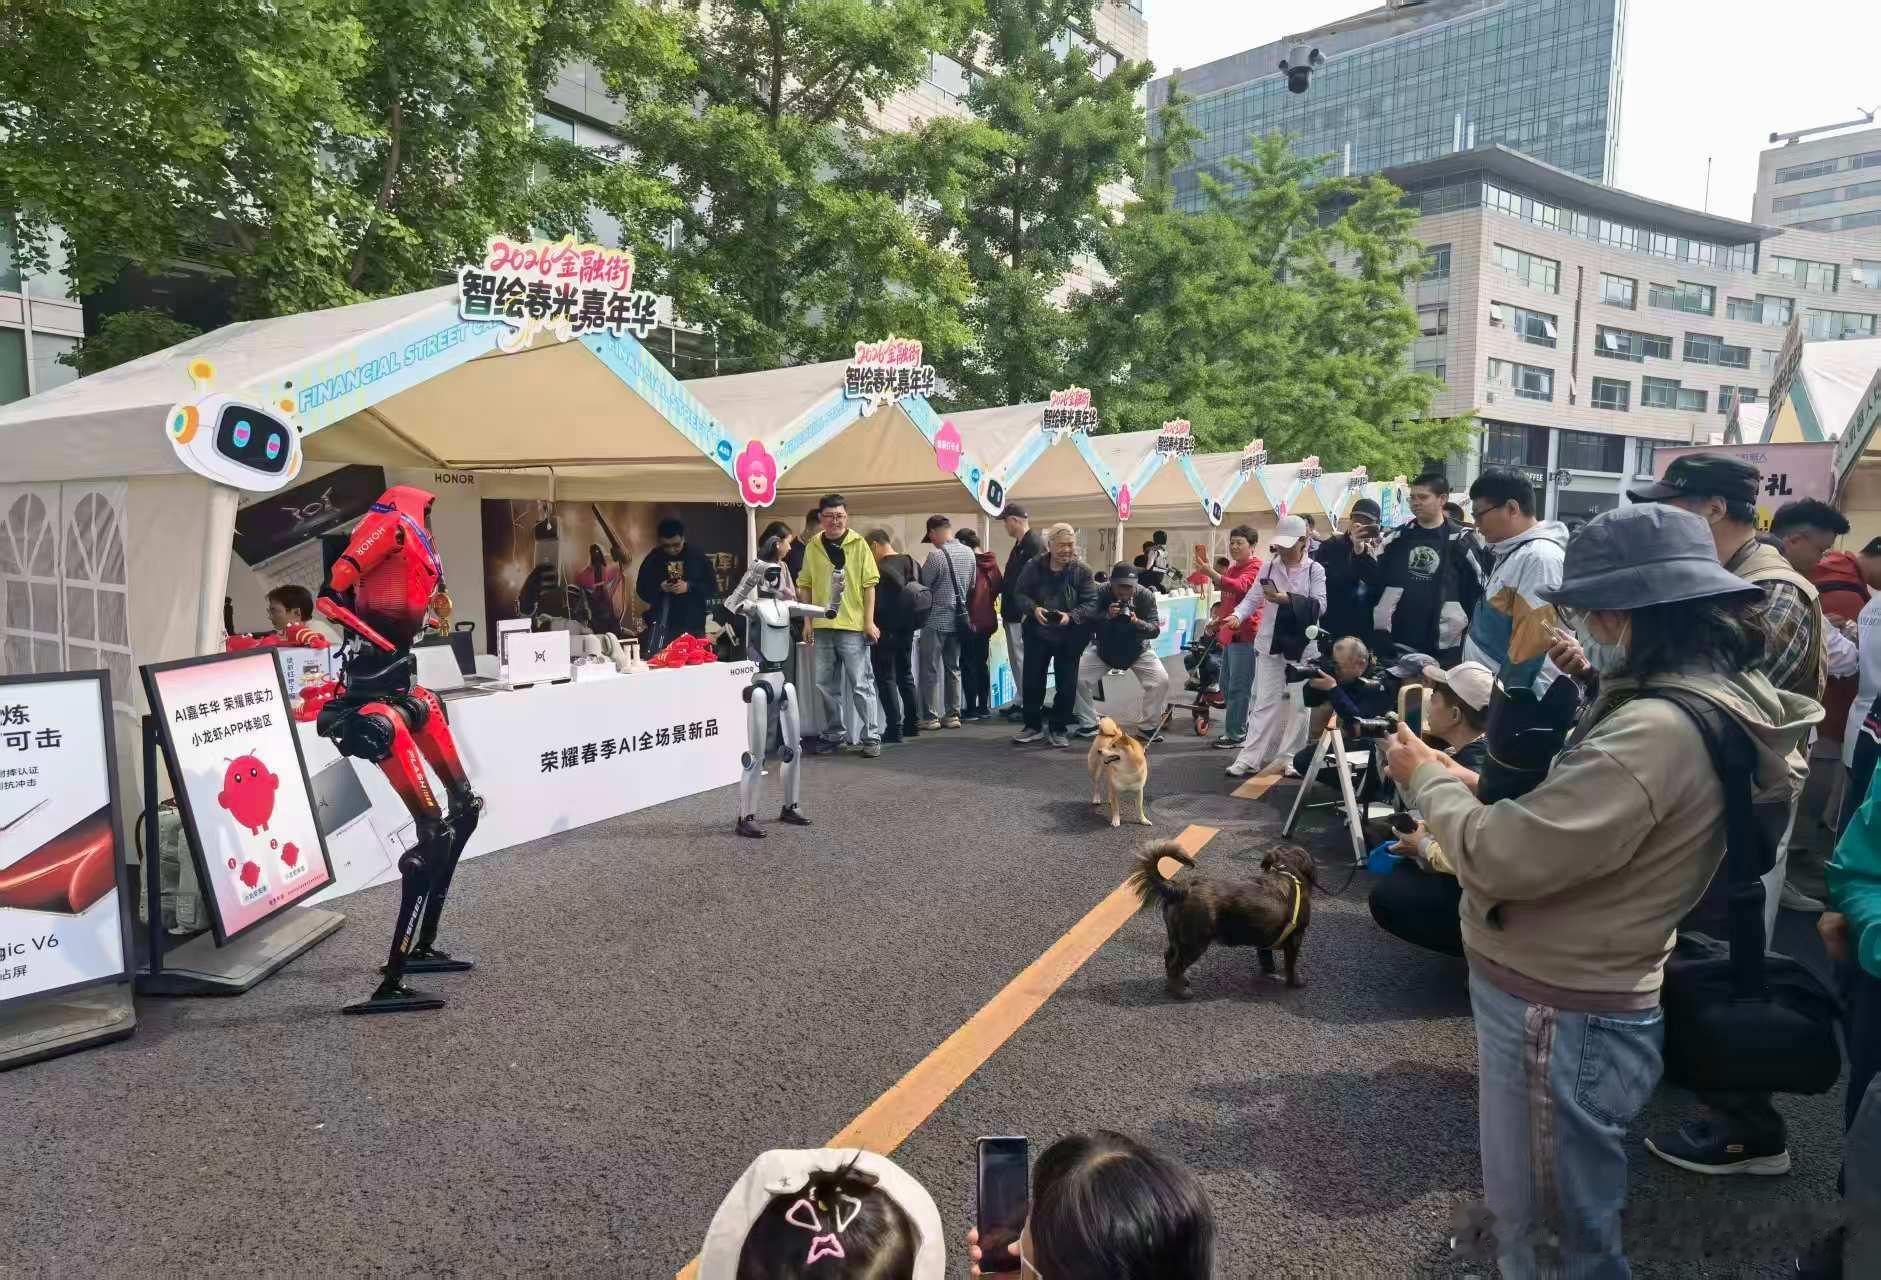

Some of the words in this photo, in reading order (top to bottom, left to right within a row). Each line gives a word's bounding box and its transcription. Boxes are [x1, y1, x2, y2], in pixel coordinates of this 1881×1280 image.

[490, 240, 630, 291] 2026金融街
[462, 269, 657, 332] 智绘春光嘉年华
[298, 352, 400, 414] FINANCIAL
[403, 322, 468, 367] STREET
[846, 366, 934, 398] 智绘春光嘉年华
[434, 472, 475, 485] HONOR
[356, 527, 386, 556] HONOR
[730, 666, 755, 676] HONOR
[175, 699, 221, 723] AI嘉年华
[223, 688, 274, 711] 荣耀展实力
[192, 713, 273, 747] 小龙虾APP体验区
[540, 718, 719, 773] 荣耀春季AI全场景新品
[406, 895, 423, 936] SPEED
[31, 934, 59, 951] V6
